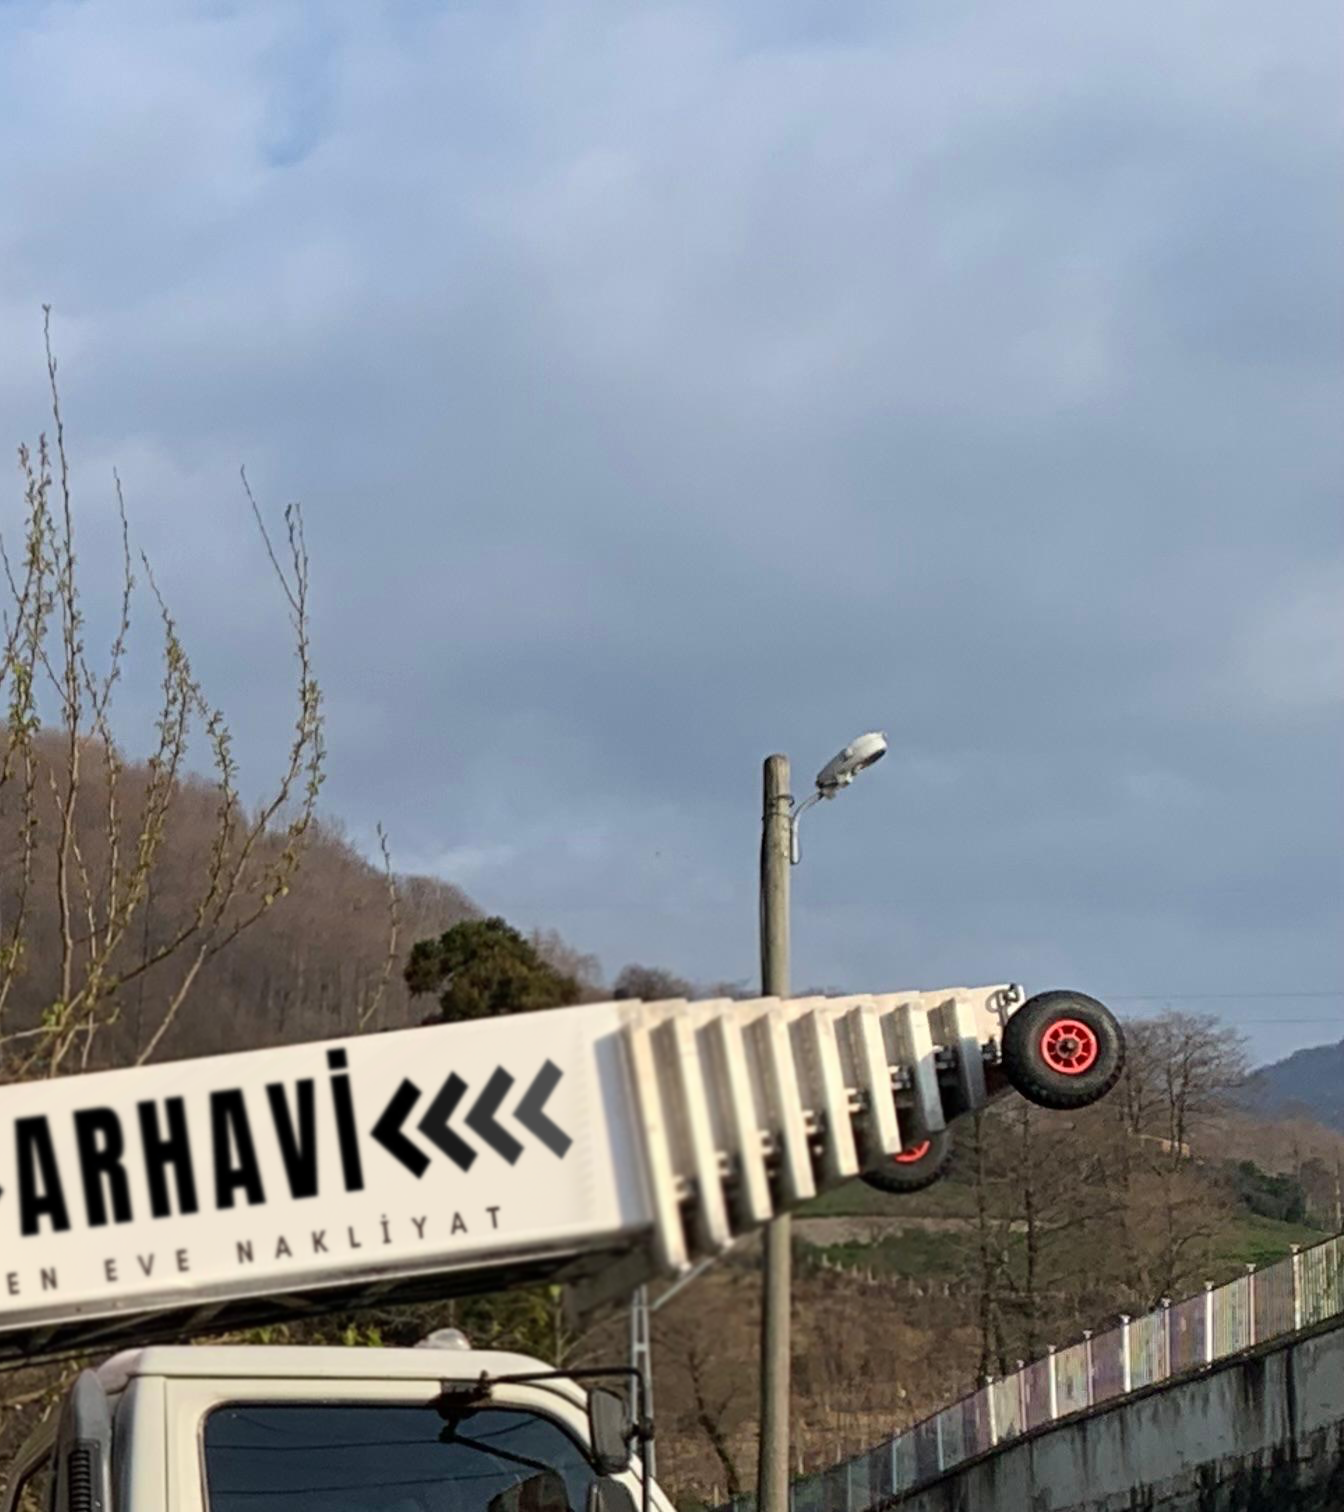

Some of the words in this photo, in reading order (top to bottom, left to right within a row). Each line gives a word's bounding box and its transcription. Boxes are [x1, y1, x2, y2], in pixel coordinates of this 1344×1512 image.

[14, 1047, 365, 1237] ARHAVİ
[104, 1249, 189, 1282] EVE
[236, 1206, 500, 1263] NAKLİYAT
